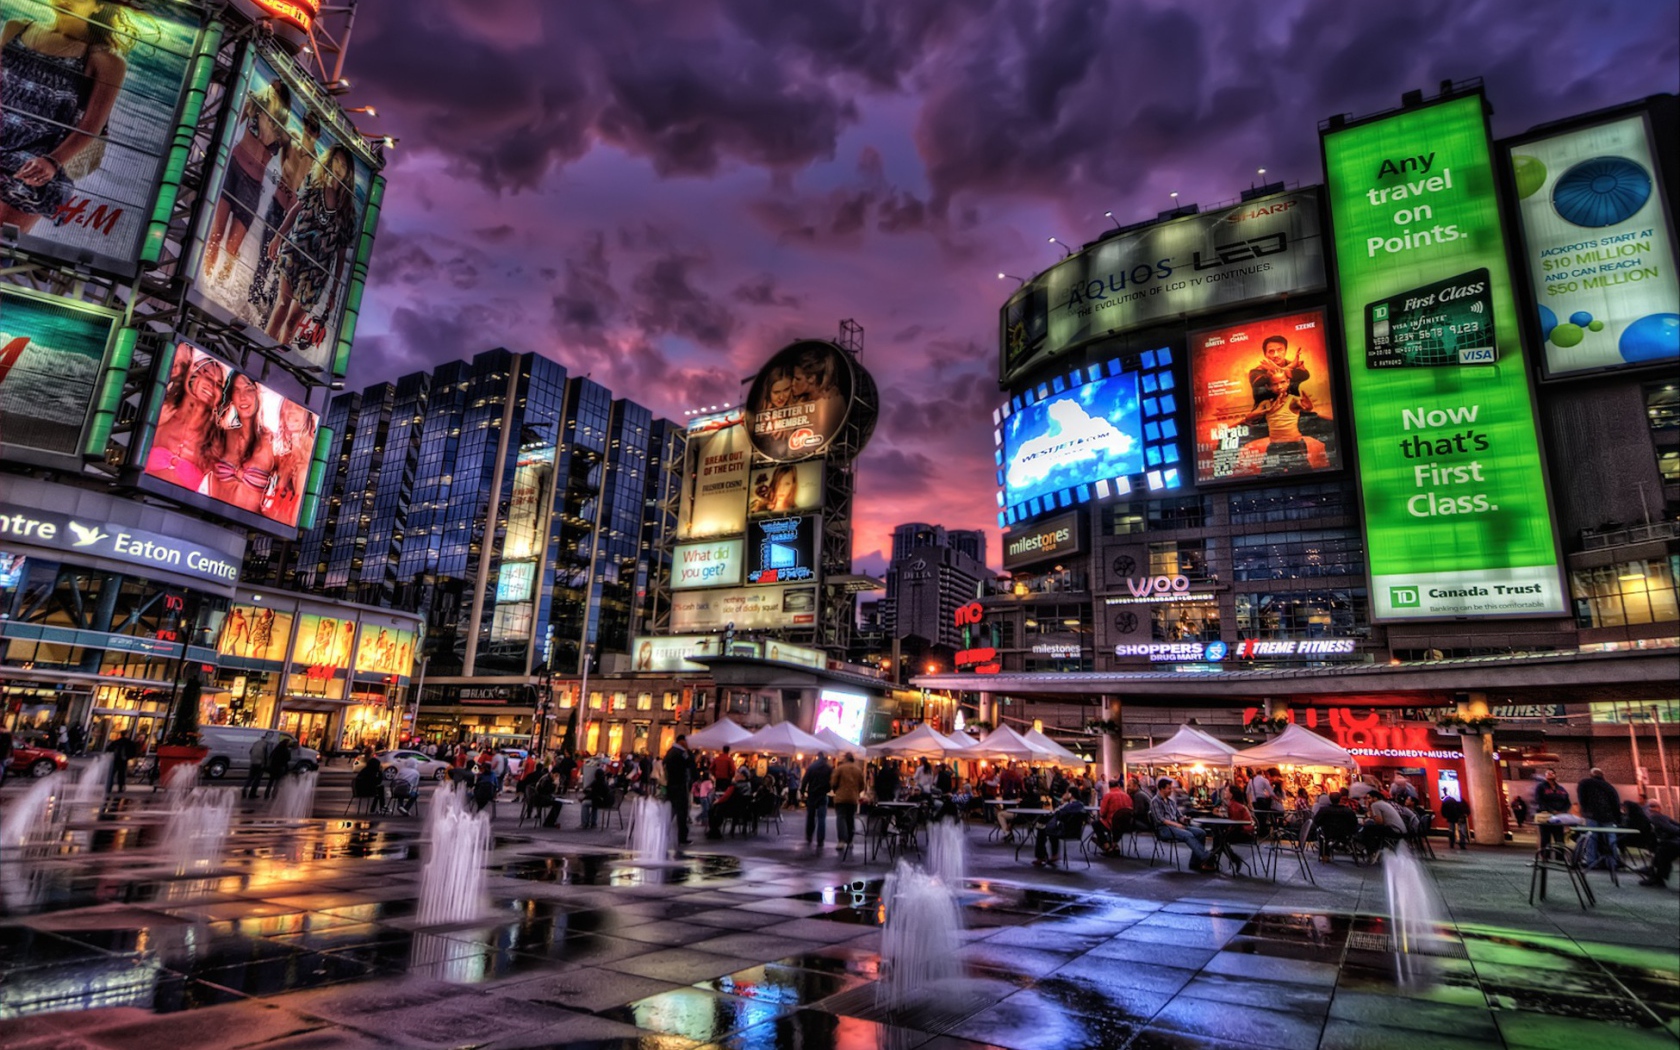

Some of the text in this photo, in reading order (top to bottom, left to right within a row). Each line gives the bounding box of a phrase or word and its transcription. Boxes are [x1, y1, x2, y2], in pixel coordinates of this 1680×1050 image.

[1378, 152, 1435, 180] Any
[1366, 168, 1452, 206] travel
[51, 194, 124, 236] H&M
[1226, 200, 1297, 225] SHARP
[1394, 205, 1432, 225] on
[1193, 231, 1287, 271] LED
[1367, 225, 1468, 257] Points.
[1541, 229, 1654, 258] JACKPOTS START AT
[1543, 241, 1652, 272] $10 MILLION
[1545, 258, 1642, 282] AND CAN REACH
[1547, 266, 1659, 296] $50 MILLION
[1067, 258, 1174, 310] AQUOS
[1077, 305, 1092, 319] THE
[1095, 288, 1147, 312] EVOLUTION
[1150, 285, 1163, 296] OF
[1165, 280, 1186, 292] LCD
[1190, 278, 1204, 286] TV
[1206, 262, 1274, 284] CONTINUES.
[1403, 282, 1485, 312] First Class
[1449, 321, 1479, 334] 9123
[1463, 350, 1492, 361] VISA
[772, 404, 802, 420] BETTER
[804, 403, 816, 414] TO
[1401, 405, 1479, 431] Now
[754, 415, 810, 433] BE A MEMBER.
[1211, 425, 1249, 440] Karate
[1399, 430, 1490, 459] that's
[704, 461, 744, 476] OF THE CITY
[705, 451, 743, 466] BREAK OUT
[1414, 461, 1485, 488] First
[1407, 492, 1499, 518] Class.
[1009, 528, 1070, 556] milestones
[113, 533, 237, 580] Eaton Centre
[683, 546, 729, 563] What did
[681, 563, 726, 582] you get?
[1126, 574, 1190, 597] WOO
[1393, 583, 1542, 605] TD Canada Trust
[1430, 603, 1458, 612] Banking
[1484, 602, 1498, 610] this
[1498, 600, 1545, 609] comfortable
[1032, 643, 1081, 653] milestones
[1115, 642, 1203, 656] SHOPPERS
[1150, 652, 1204, 661] DRUG MART
[1236, 638, 1354, 659] EXTREME FITNESS
[1352, 749, 1459, 759] OPERA COMEDY MUSIC
